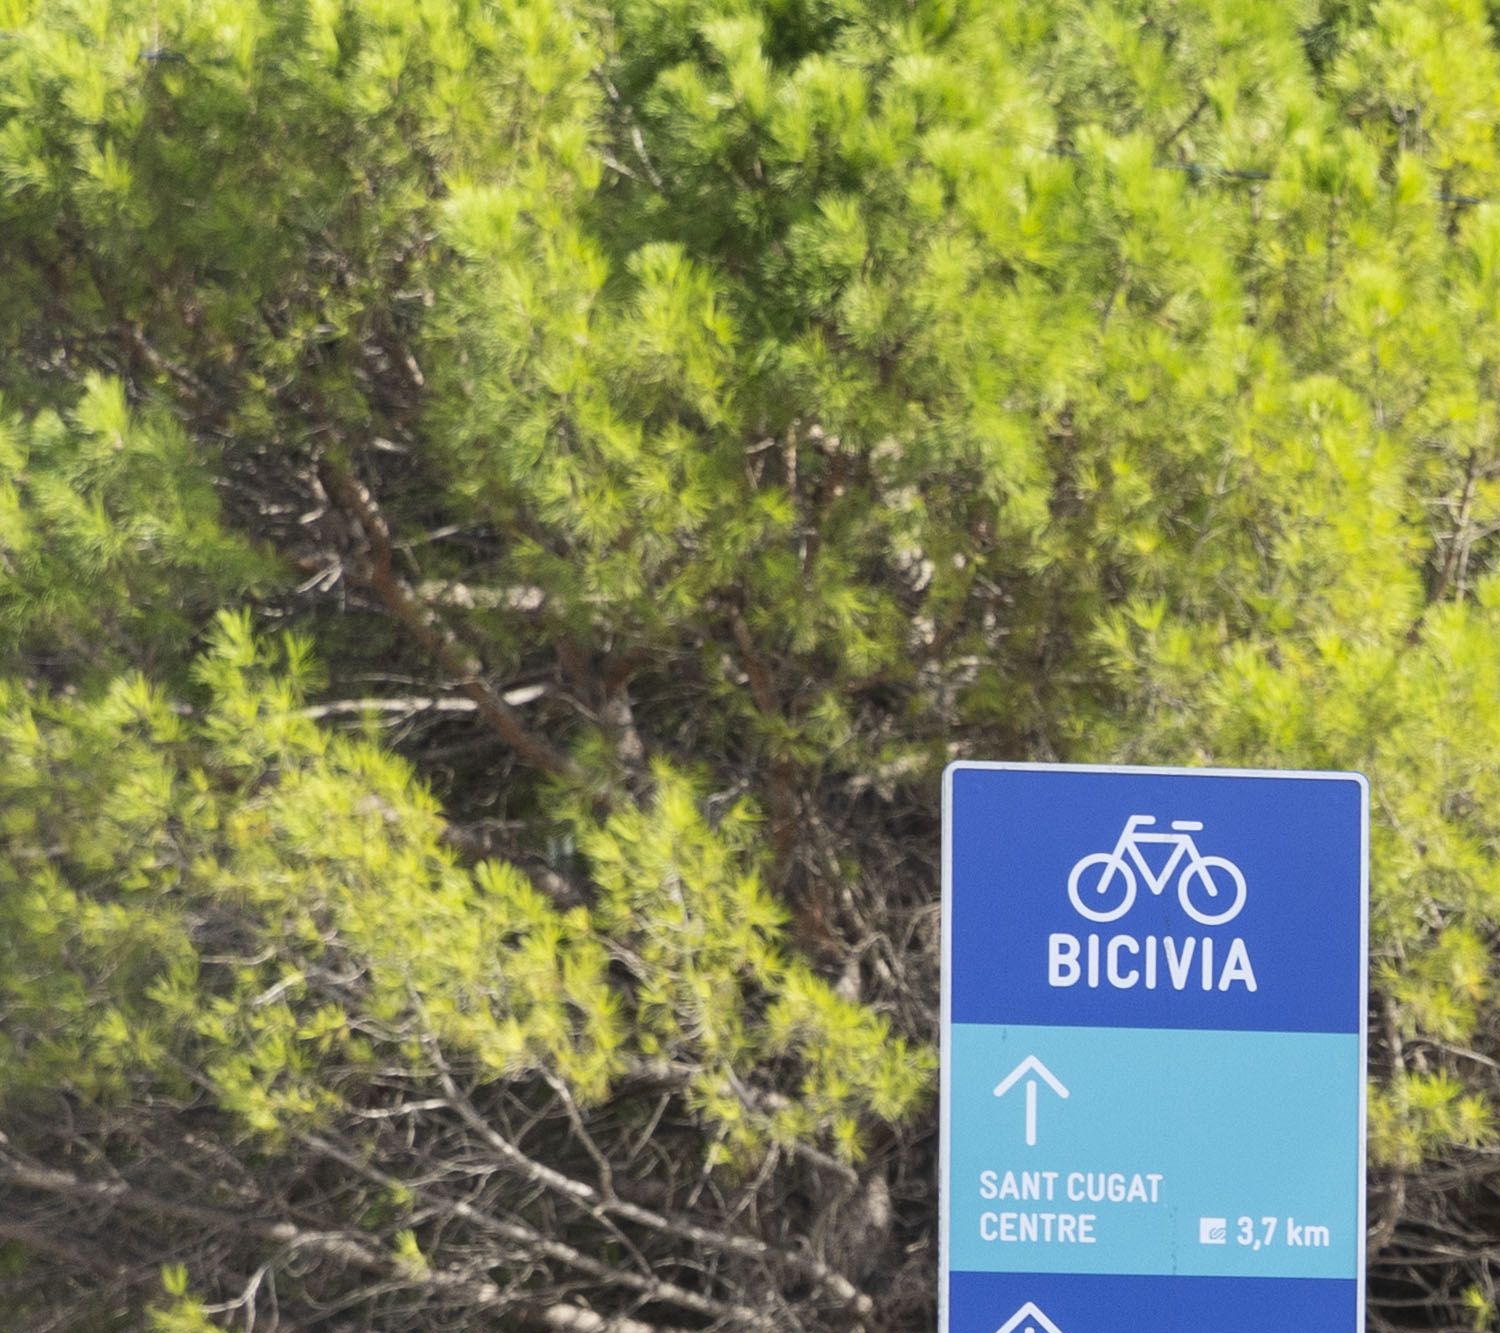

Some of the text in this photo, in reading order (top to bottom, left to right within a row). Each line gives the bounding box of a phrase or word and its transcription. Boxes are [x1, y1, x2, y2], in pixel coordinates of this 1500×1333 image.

[1048, 933, 1258, 993] BICIVIA
[979, 1170, 1163, 1203] SANT CUGAT
[980, 1211, 1330, 1251] CENTRE 3,7 km
